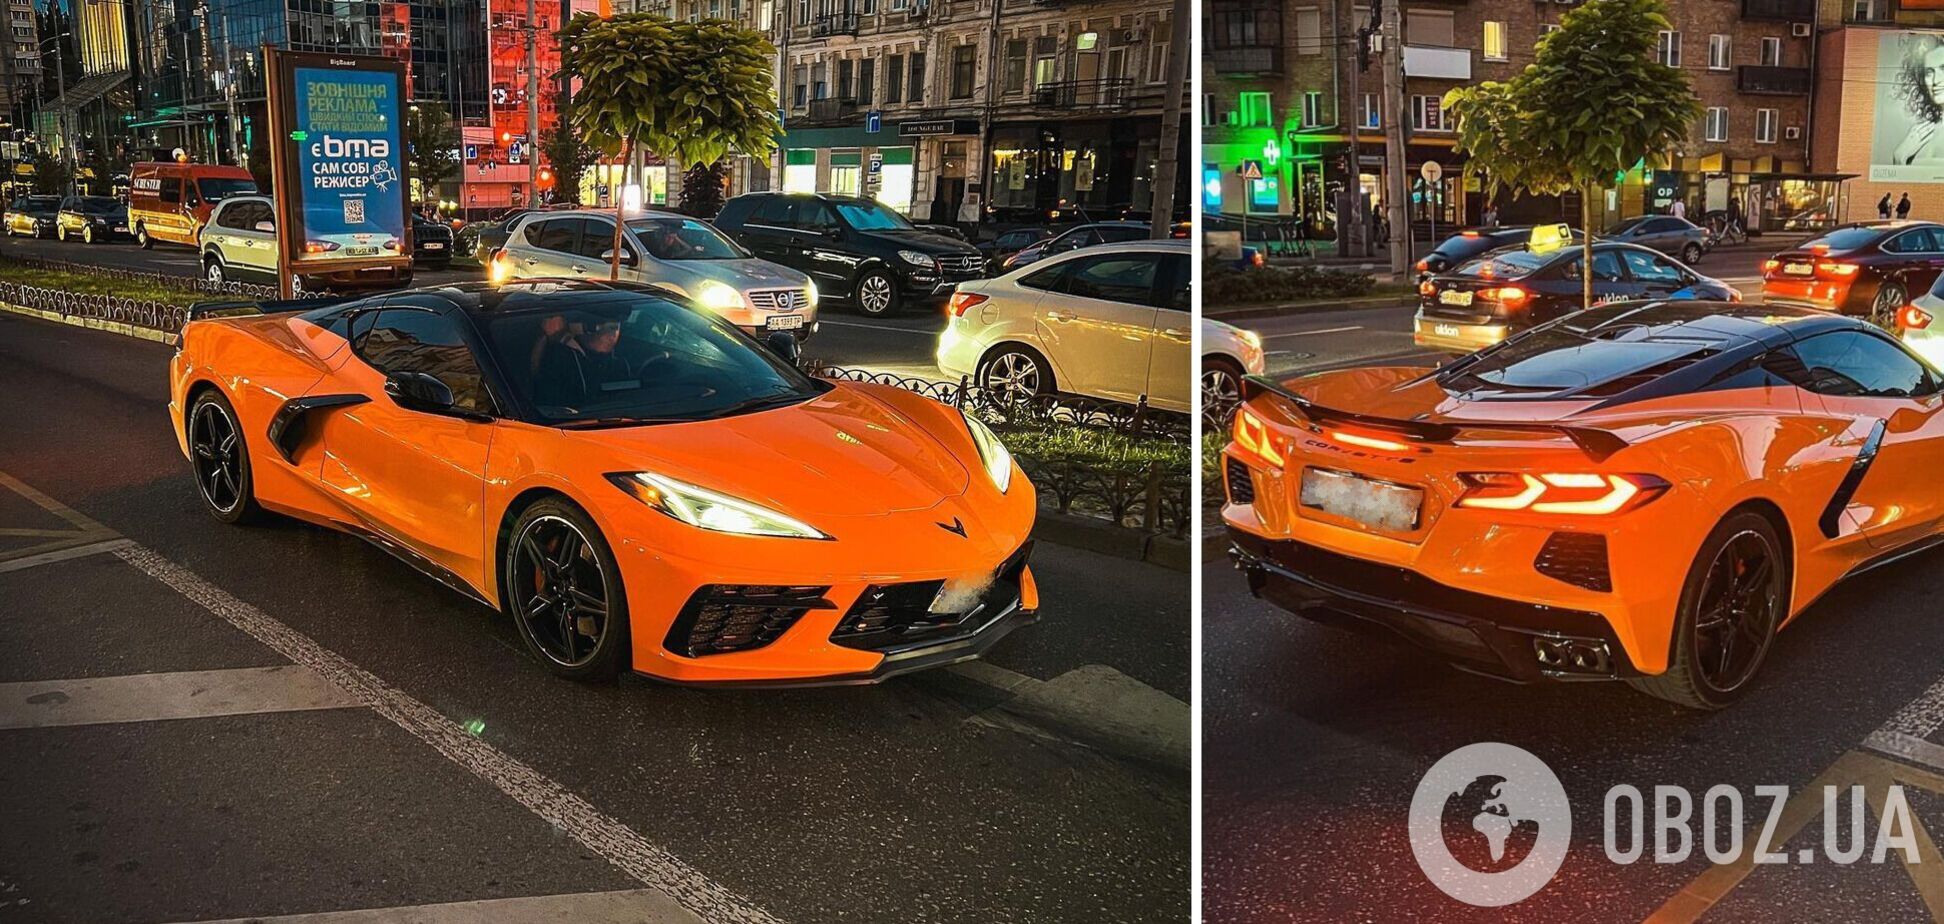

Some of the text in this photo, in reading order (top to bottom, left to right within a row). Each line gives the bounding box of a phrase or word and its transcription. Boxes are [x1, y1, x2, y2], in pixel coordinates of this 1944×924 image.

[330, 58, 356, 66] BigBoard
[307, 82, 387, 98] ЗОВНІШНЯ
[309, 97, 378, 113] РЕКЛАМА
[310, 121, 340, 132] СТАТИ
[323, 134, 389, 159] bma
[312, 161, 369, 175] САМ СОБІ
[871, 161, 881, 172] P
[313, 175, 370, 188] РЕЖИСЕР
[1598, 292, 1629, 305] uklon
[1435, 323, 1459, 337] uklon
[1305, 439, 1416, 464] CORVETTE
